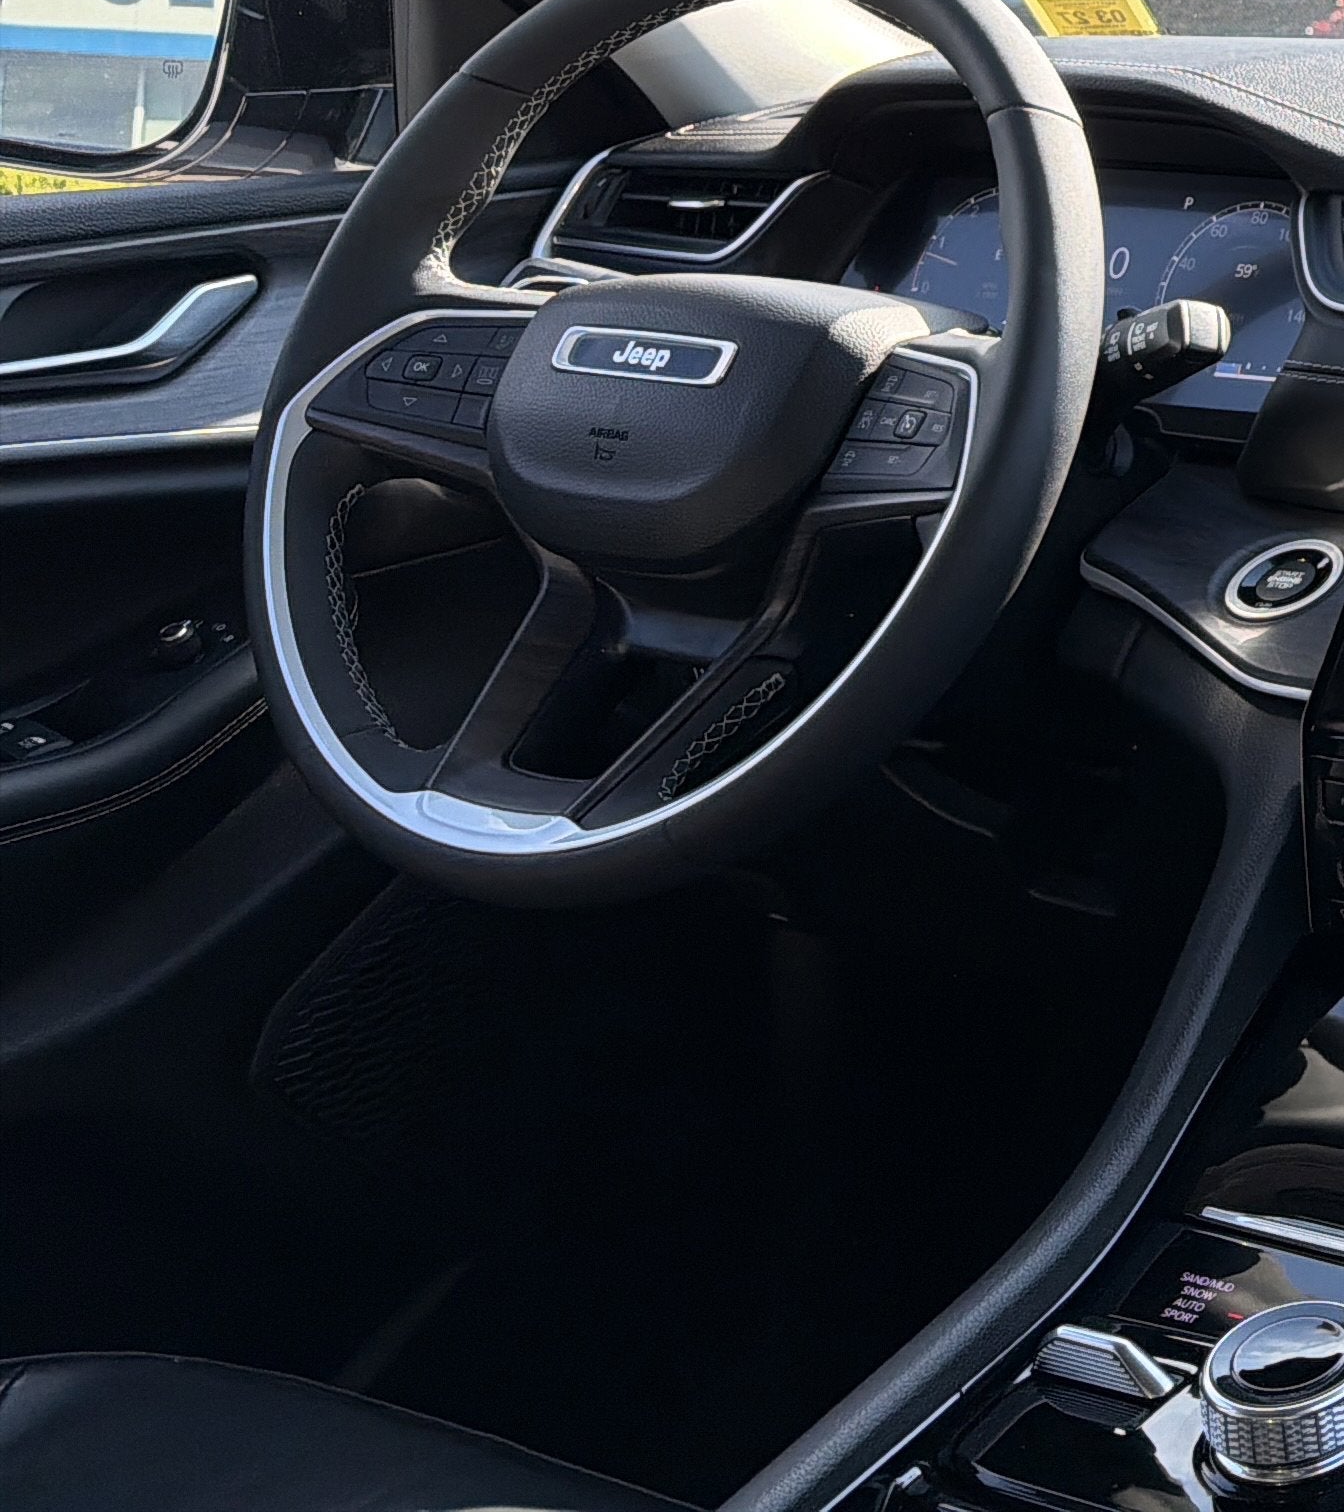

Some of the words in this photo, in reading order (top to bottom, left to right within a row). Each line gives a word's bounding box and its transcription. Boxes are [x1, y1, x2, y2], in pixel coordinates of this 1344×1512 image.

[1184, 195, 1195, 211] P
[1251, 211, 1269, 225] 80
[1210, 224, 1228, 238] 60
[1109, 246, 1130, 279] 0
[1179, 257, 1196, 271] 40
[612, 340, 671, 371] Jeep
[413, 361, 431, 374] OK
[588, 426, 630, 442] AIRBAG
[1180, 1271, 1235, 1293] SAND/MUD
[1180, 1285, 1217, 1301] SNOW
[1172, 1297, 1206, 1312] AUTO
[1160, 1307, 1200, 1324] SPORT
